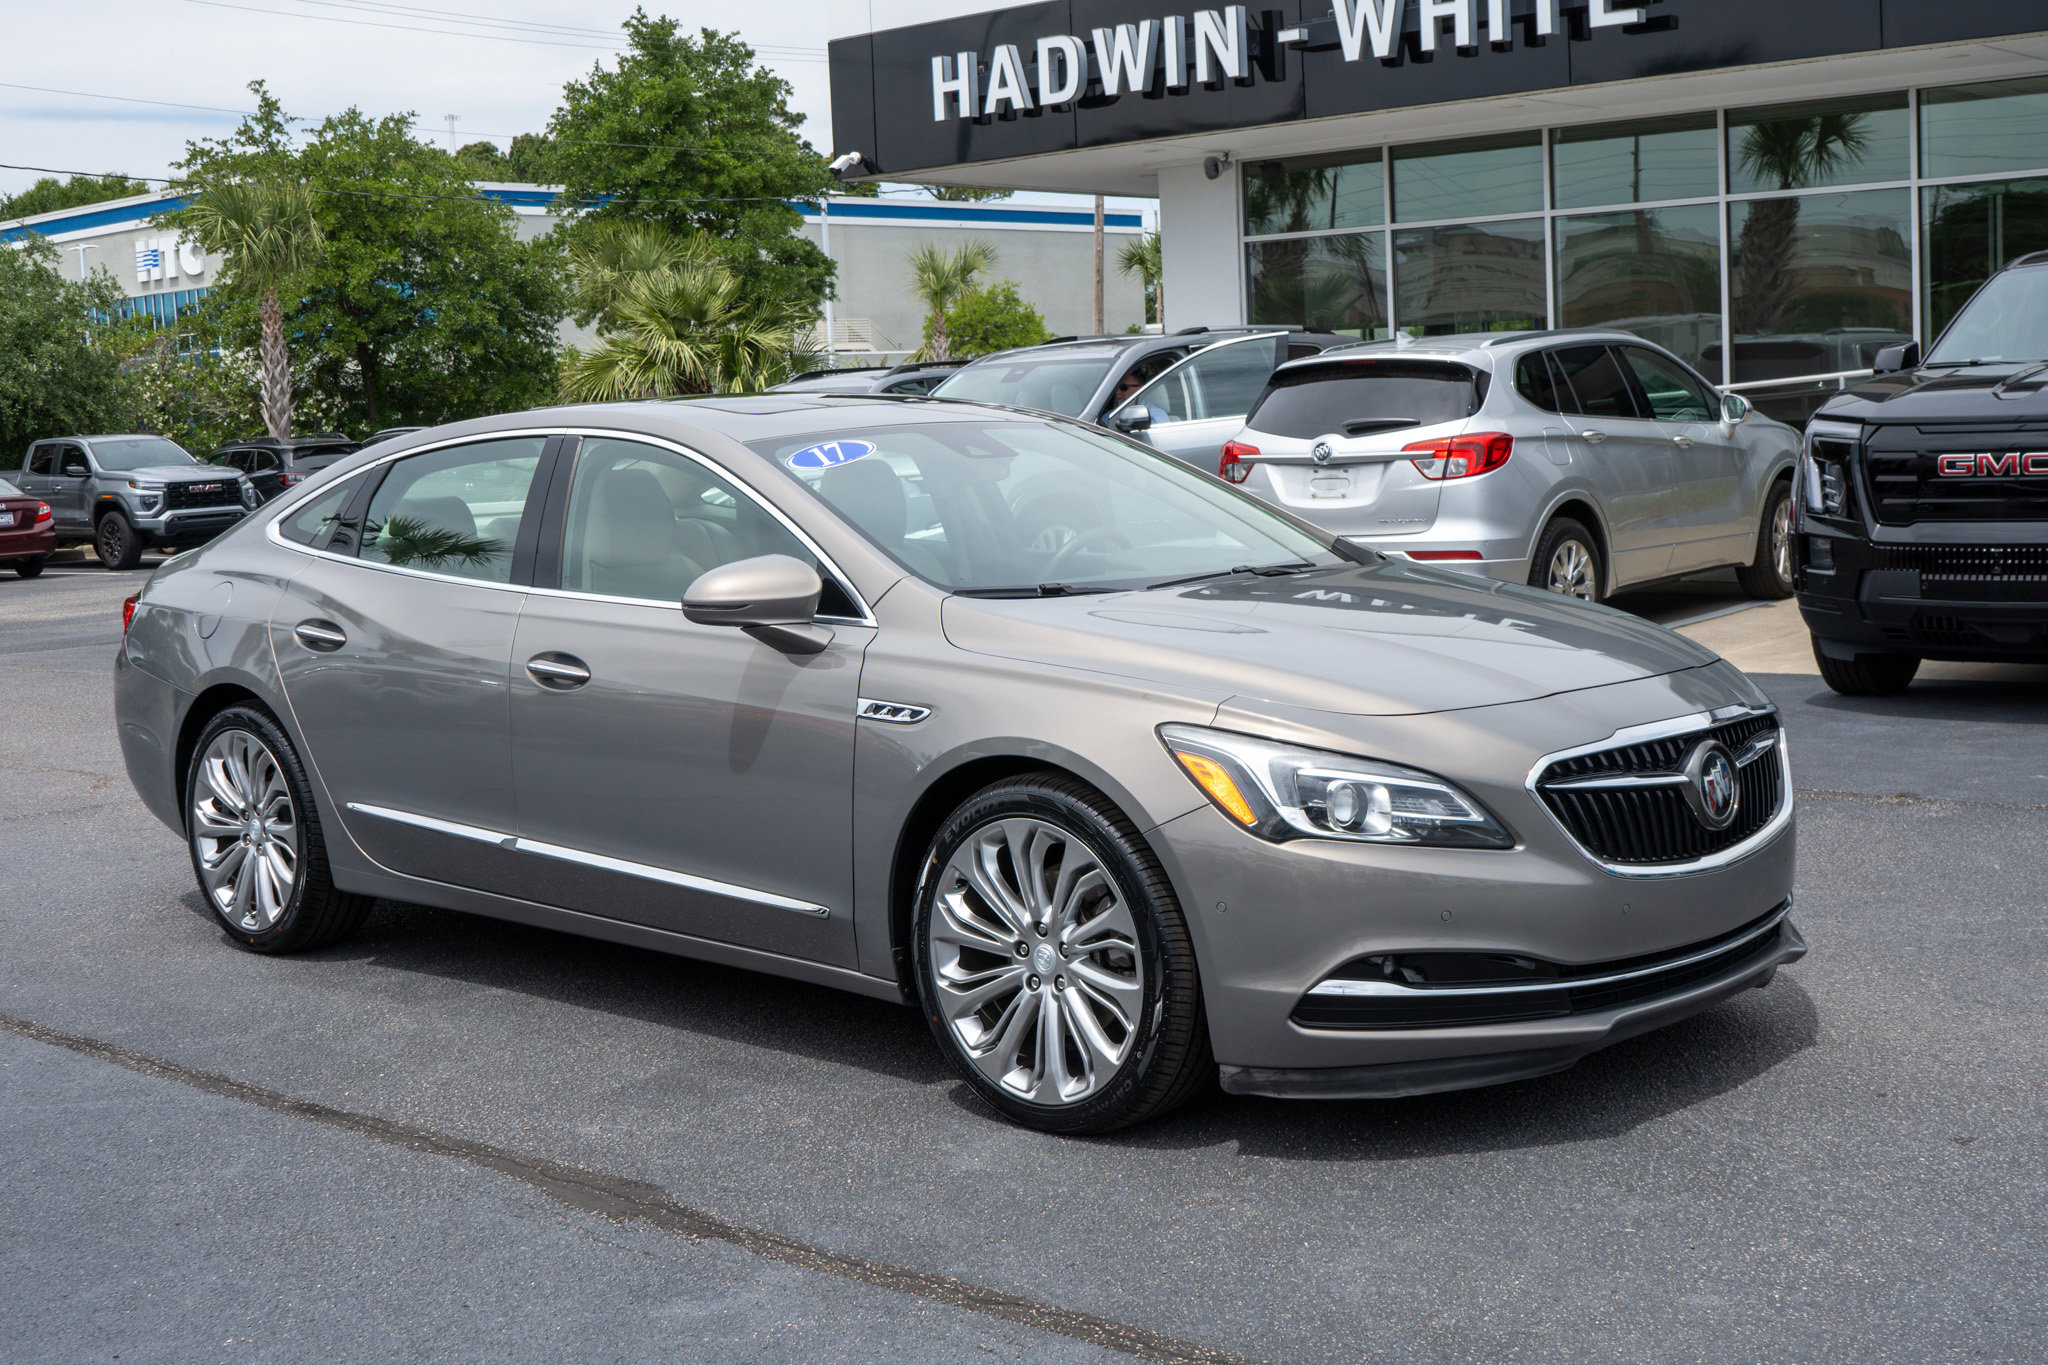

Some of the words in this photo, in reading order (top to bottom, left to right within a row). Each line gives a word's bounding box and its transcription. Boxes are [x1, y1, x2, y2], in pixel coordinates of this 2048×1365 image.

[931, 5, 1248, 121] HADWIN
[135, 236, 204, 283] HTC
[808, 442, 845, 467] 17
[1938, 452, 2048, 476] GMC
